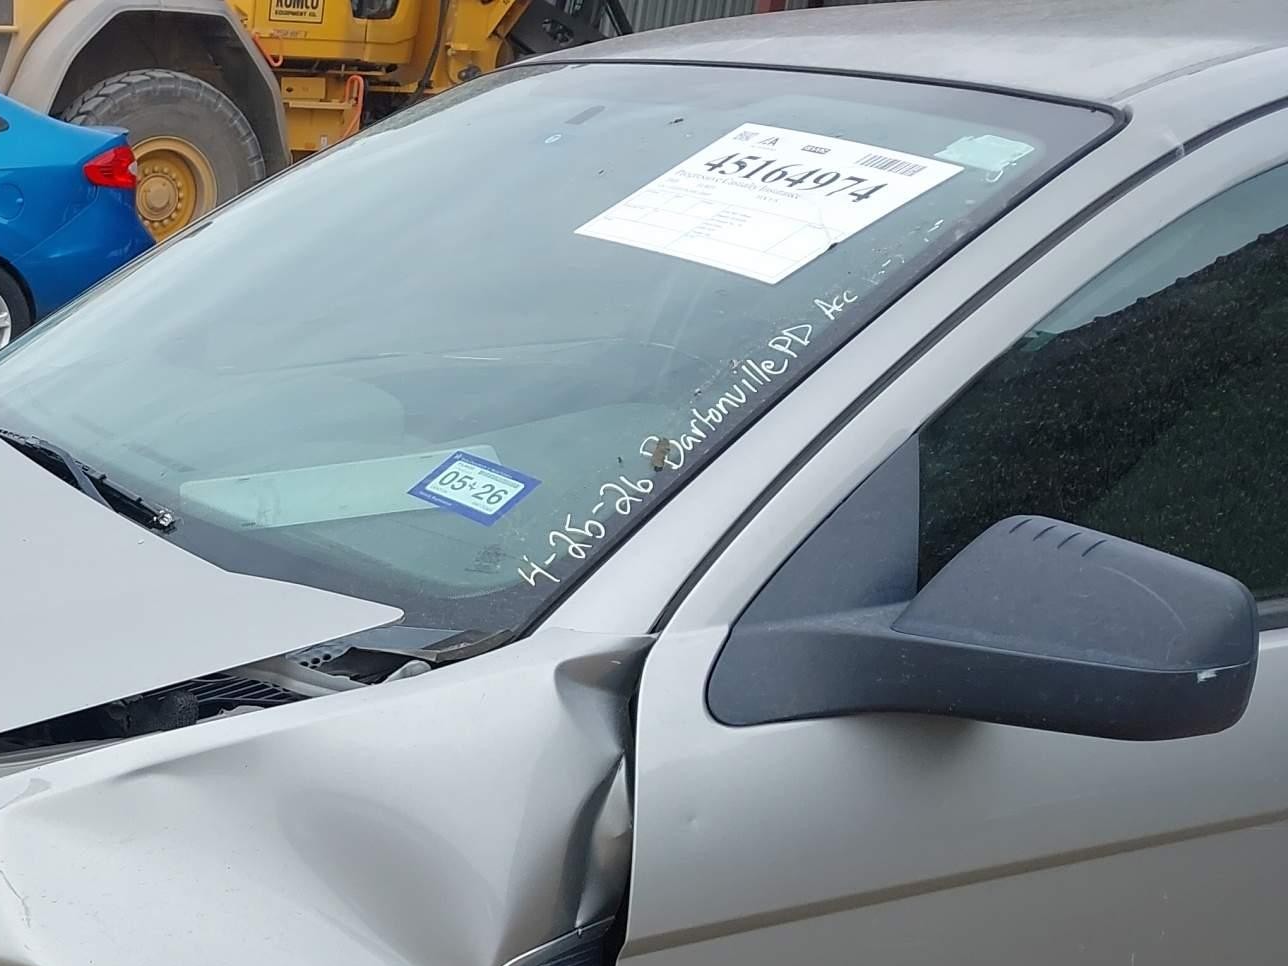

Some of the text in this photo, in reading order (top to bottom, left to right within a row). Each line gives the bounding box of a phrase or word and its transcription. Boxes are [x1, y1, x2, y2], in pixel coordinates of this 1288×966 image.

[704, 152, 889, 203] 45164974
[518, 476, 654, 587] 4-25-26
[768, 324, 813, 358] PD
[439, 470, 474, 491] 05
[471, 483, 509, 505] 26
